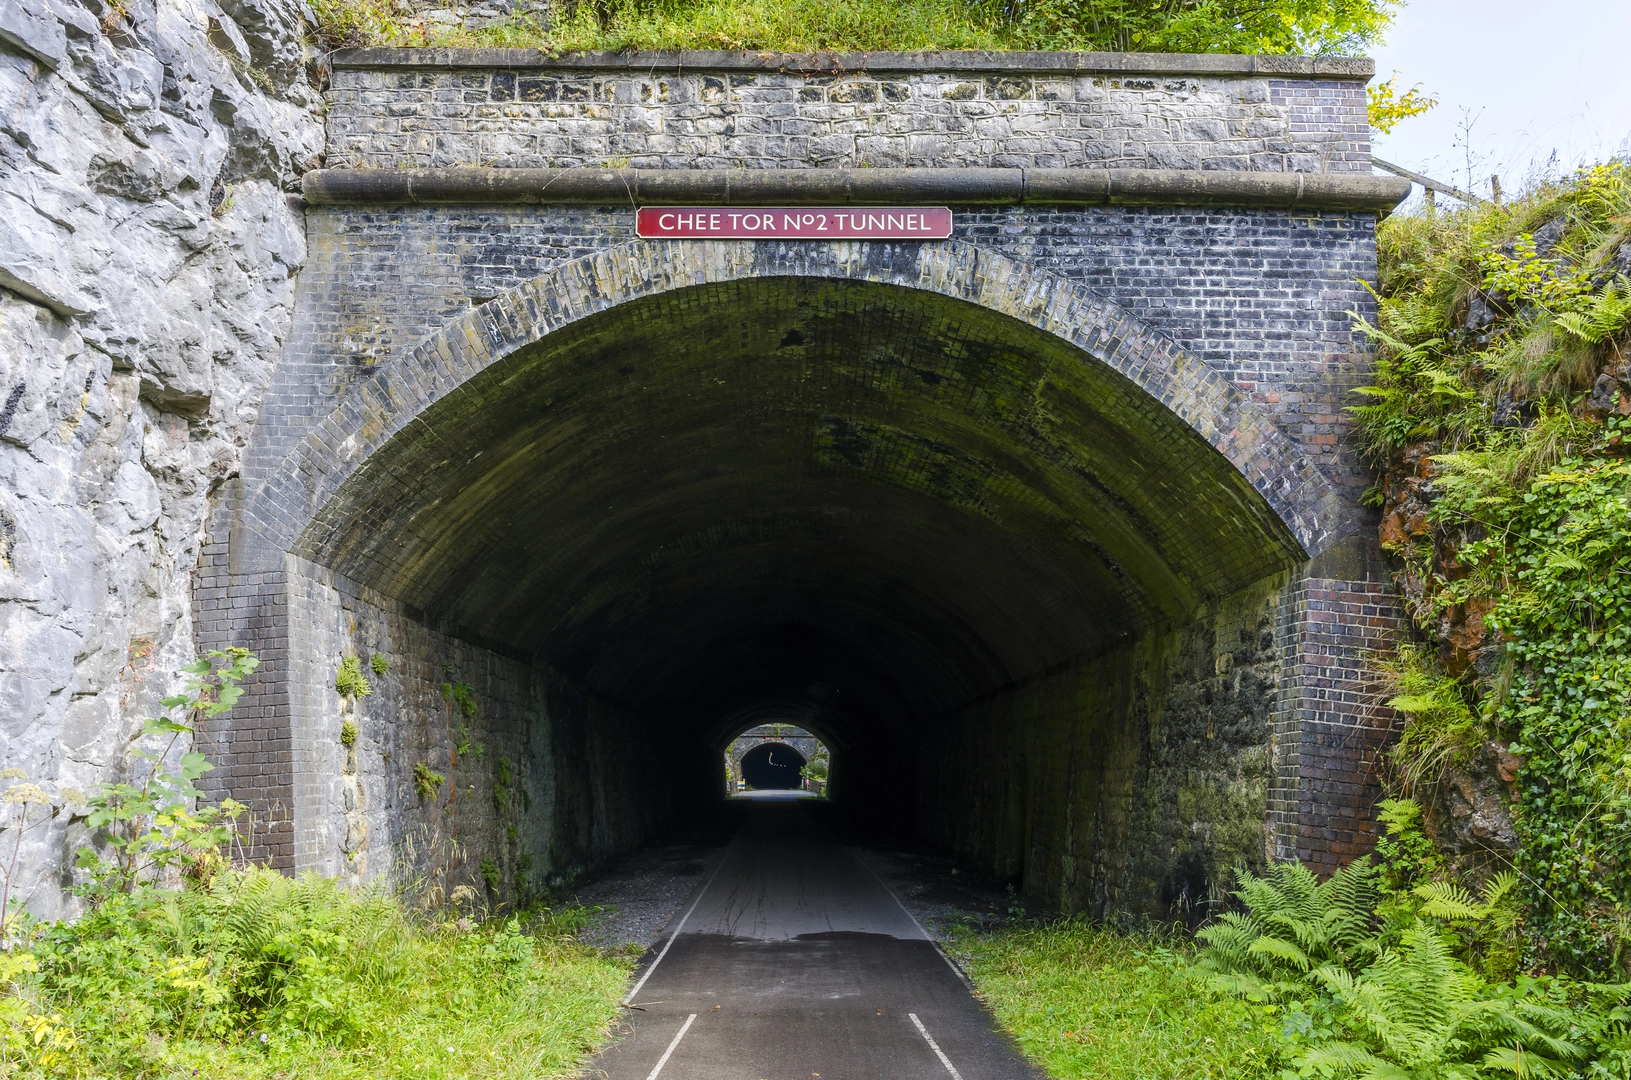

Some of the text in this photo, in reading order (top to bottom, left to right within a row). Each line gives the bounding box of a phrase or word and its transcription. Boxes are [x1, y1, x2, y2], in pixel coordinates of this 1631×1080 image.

[658, 213, 721, 231] CHEE
[728, 213, 777, 231] TOR
[834, 213, 932, 231] TUNNEL
